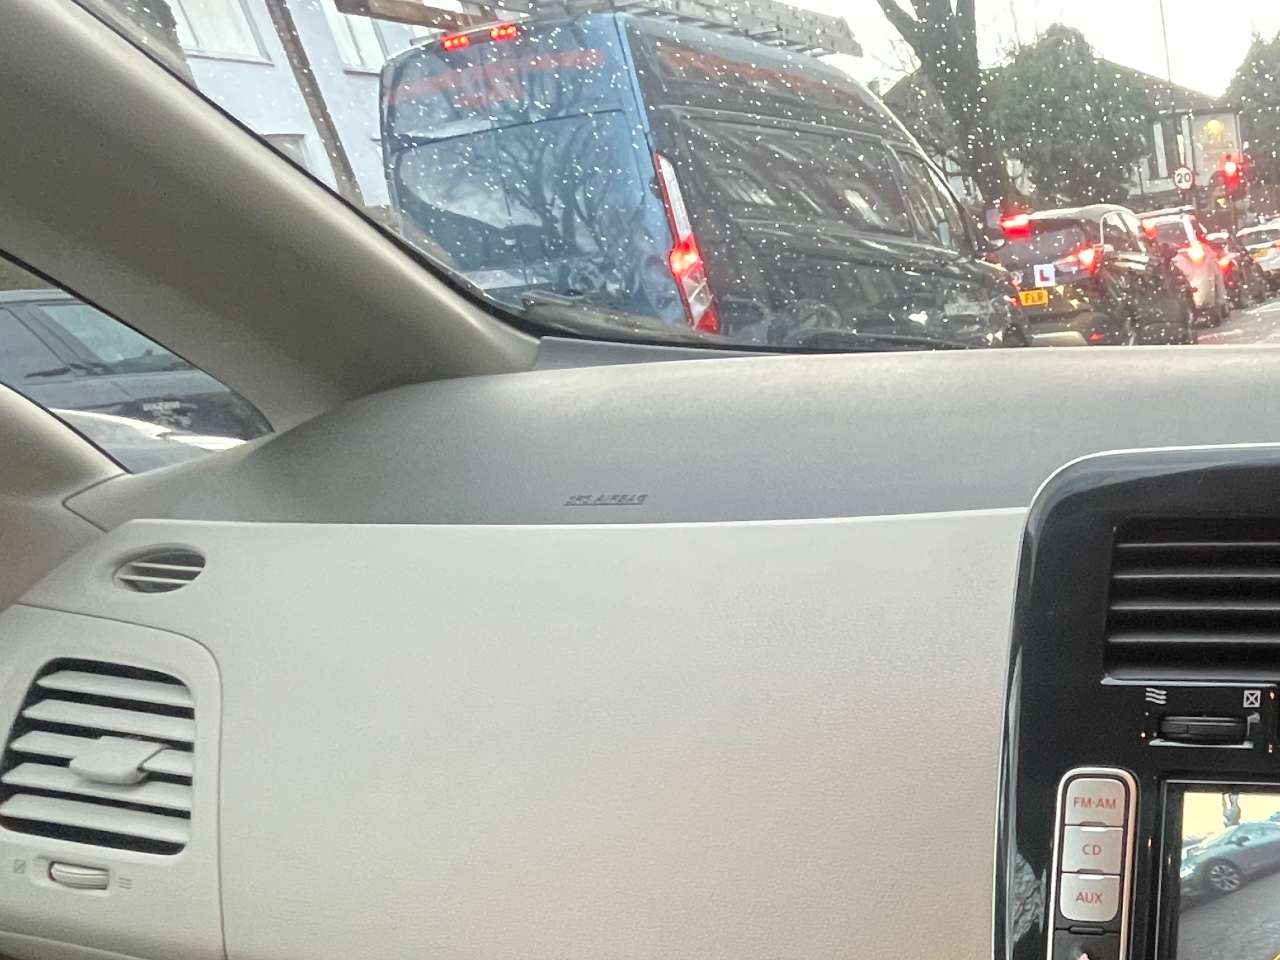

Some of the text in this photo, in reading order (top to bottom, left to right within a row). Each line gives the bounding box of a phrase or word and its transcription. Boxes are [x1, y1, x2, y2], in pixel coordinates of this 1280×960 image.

[1176, 172, 1191, 184] 20
[1082, 844, 1102, 856] CD
[1075, 892, 1104, 904] AUX
